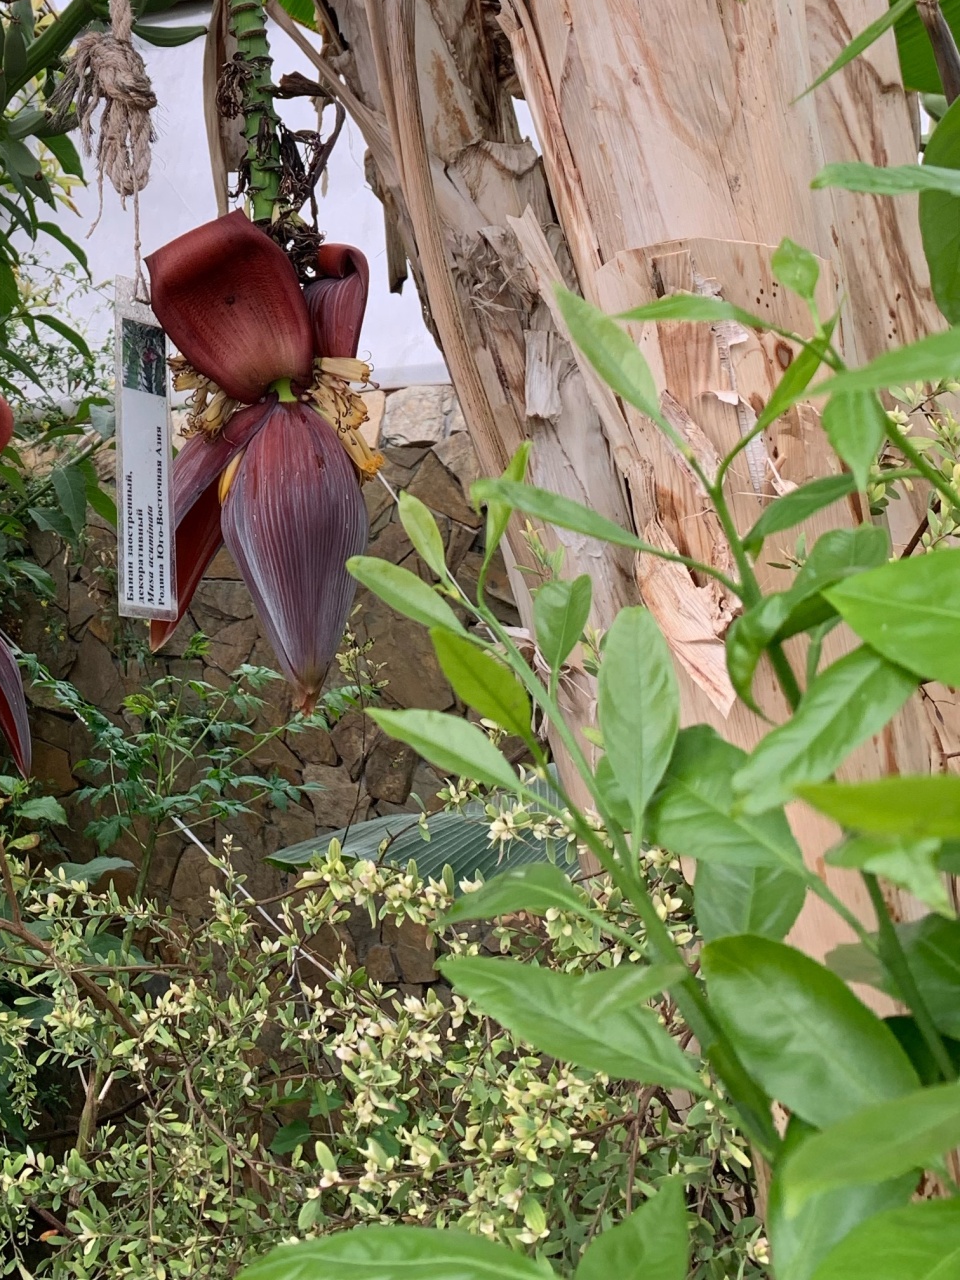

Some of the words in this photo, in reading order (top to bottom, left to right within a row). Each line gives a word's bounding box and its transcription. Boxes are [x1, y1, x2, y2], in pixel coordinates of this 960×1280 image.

[125, 471, 135, 557] заостренный,
[146, 504, 154, 568] acuminata
[155, 460, 164, 560] Юго-Восточная
[126, 561, 134, 602] Банан
[136, 508, 145, 604] декоративный
[147, 571, 155, 605] Musa
